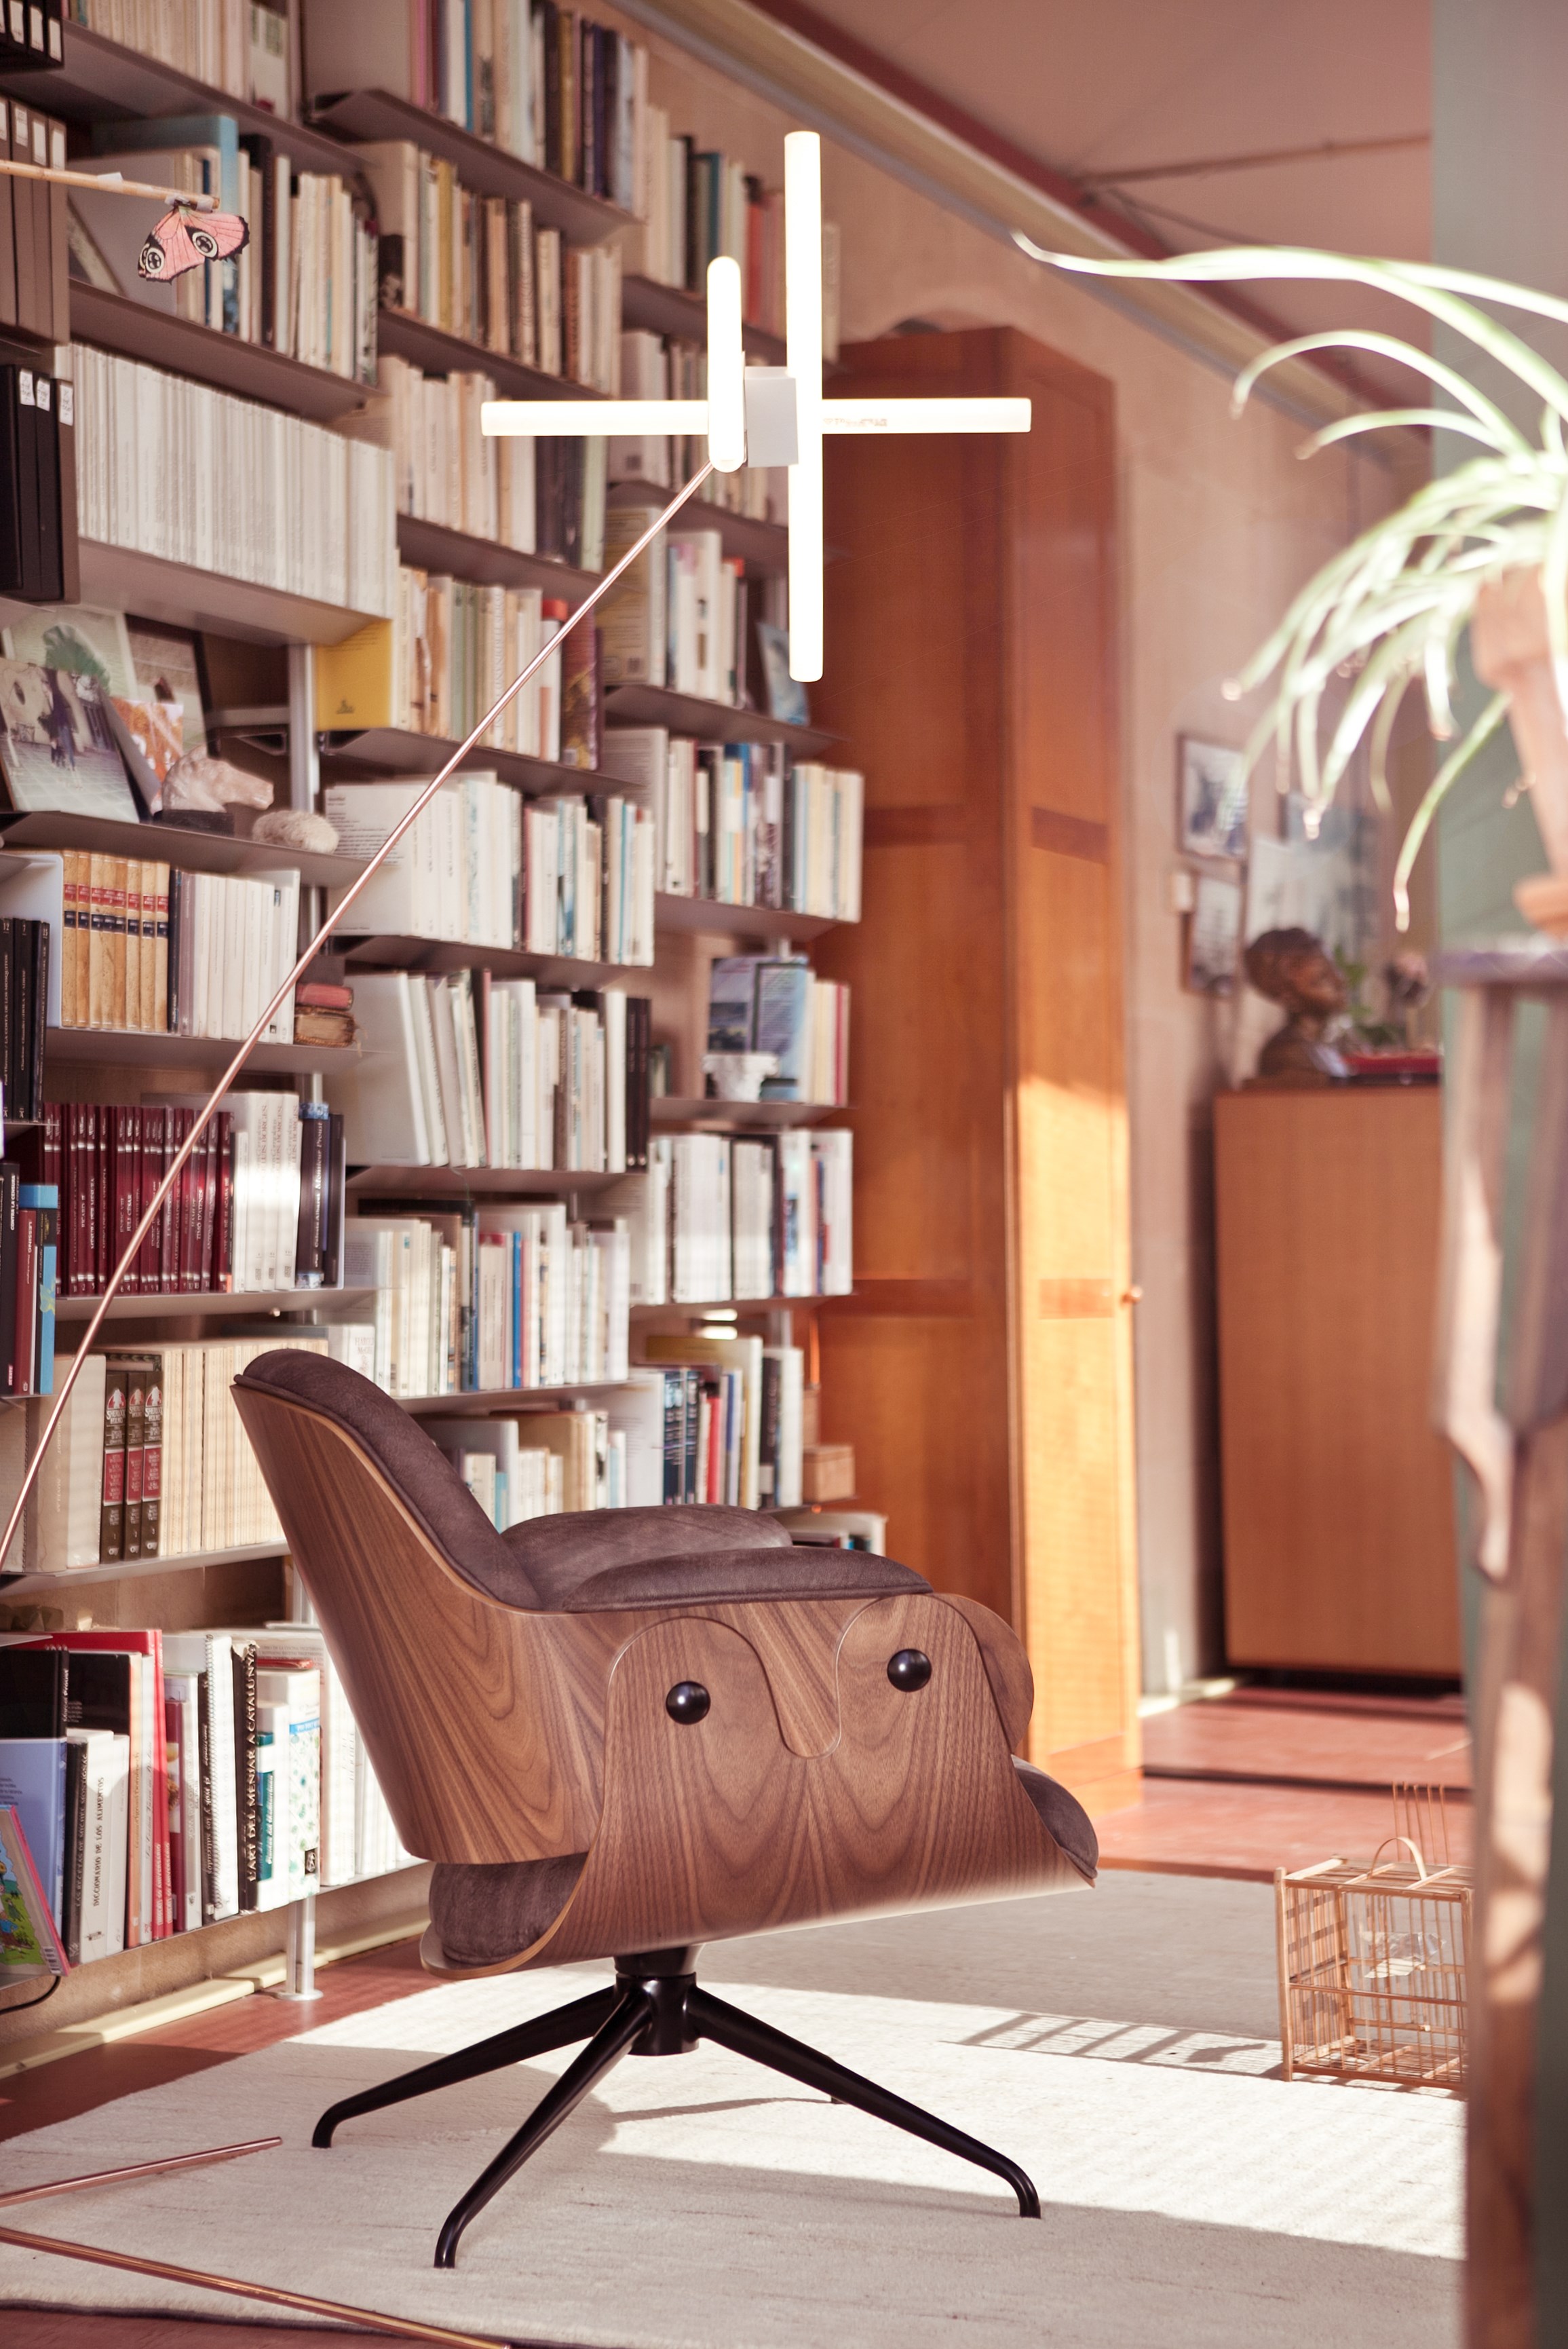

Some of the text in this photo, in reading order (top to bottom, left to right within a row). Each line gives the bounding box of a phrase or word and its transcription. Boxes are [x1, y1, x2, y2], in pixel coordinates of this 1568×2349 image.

[245, 1645, 256, 1881] L'ART DEL MENJAR A CATALUNYA
[77, 1841, 83, 1852] DE
[96, 1842, 102, 1854] DE
[155, 1842, 163, 1890] ANIVERSARIO
[93, 1856, 102, 1906] DICCIONARIO
